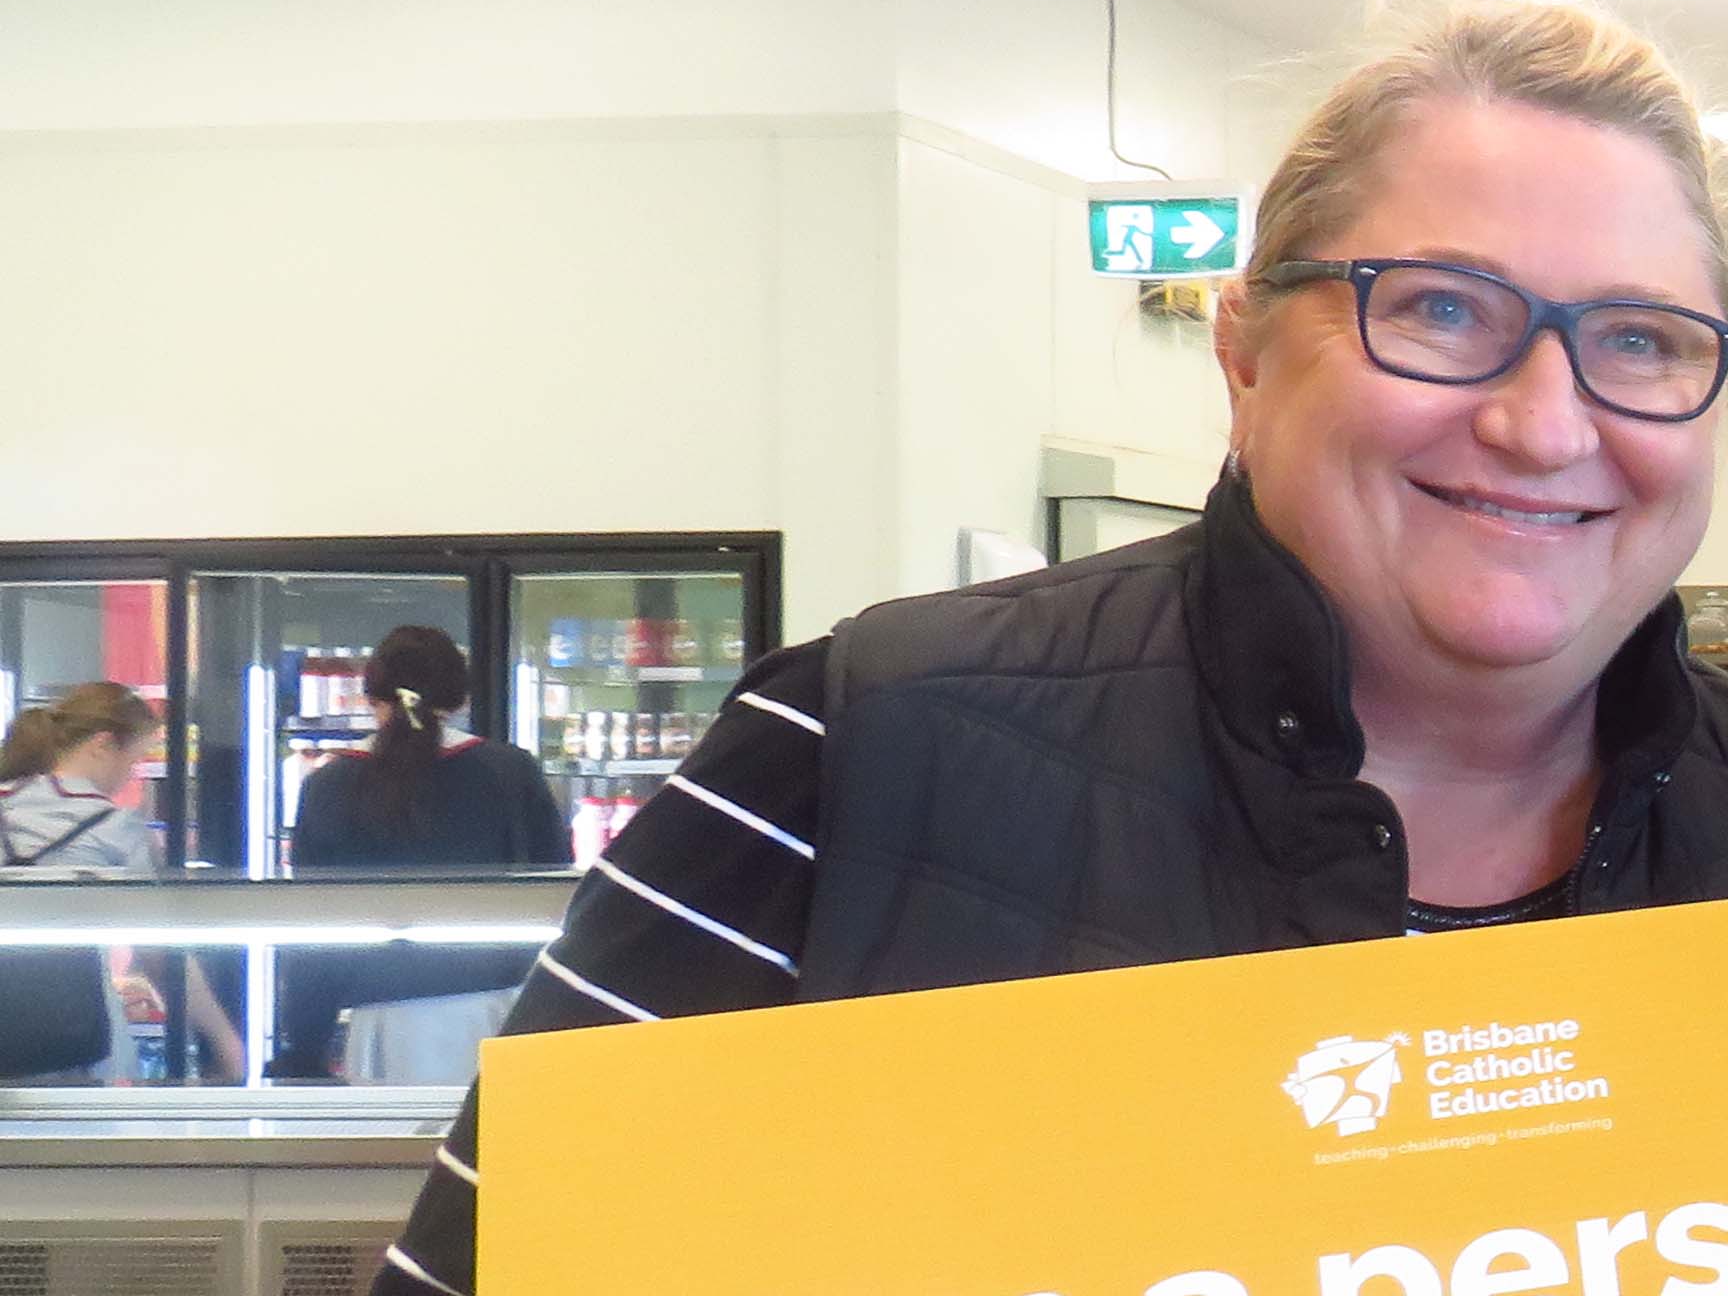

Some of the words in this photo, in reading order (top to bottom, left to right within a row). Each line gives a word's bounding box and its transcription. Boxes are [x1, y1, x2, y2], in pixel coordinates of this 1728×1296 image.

[1422, 1019, 1580, 1057] Brisbane
[1426, 1046, 1575, 1087] Catholic
[1428, 1076, 1610, 1120] Education
